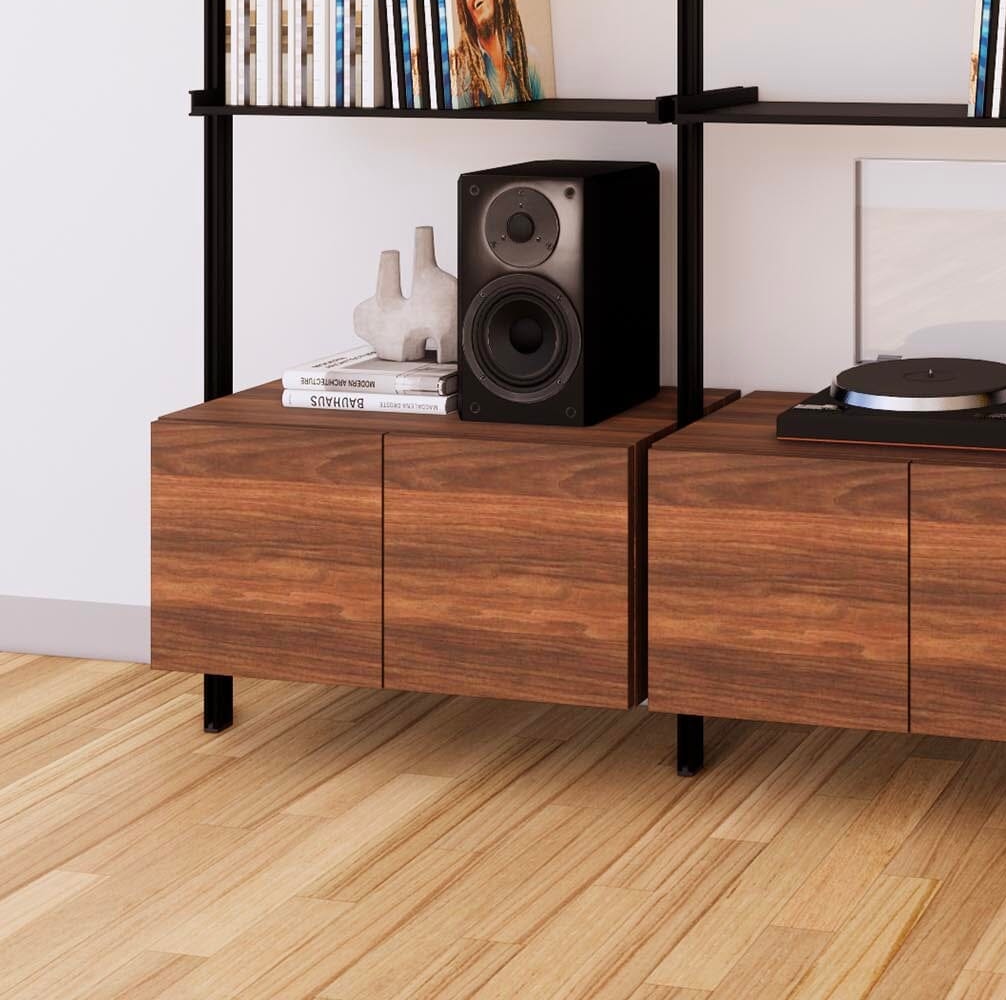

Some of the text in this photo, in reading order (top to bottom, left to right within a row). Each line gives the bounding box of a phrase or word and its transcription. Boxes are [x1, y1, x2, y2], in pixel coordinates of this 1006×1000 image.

[300, 377, 376, 389] MODERN ARCHITECTURE
[310, 395, 364, 409] BAUHAUS
